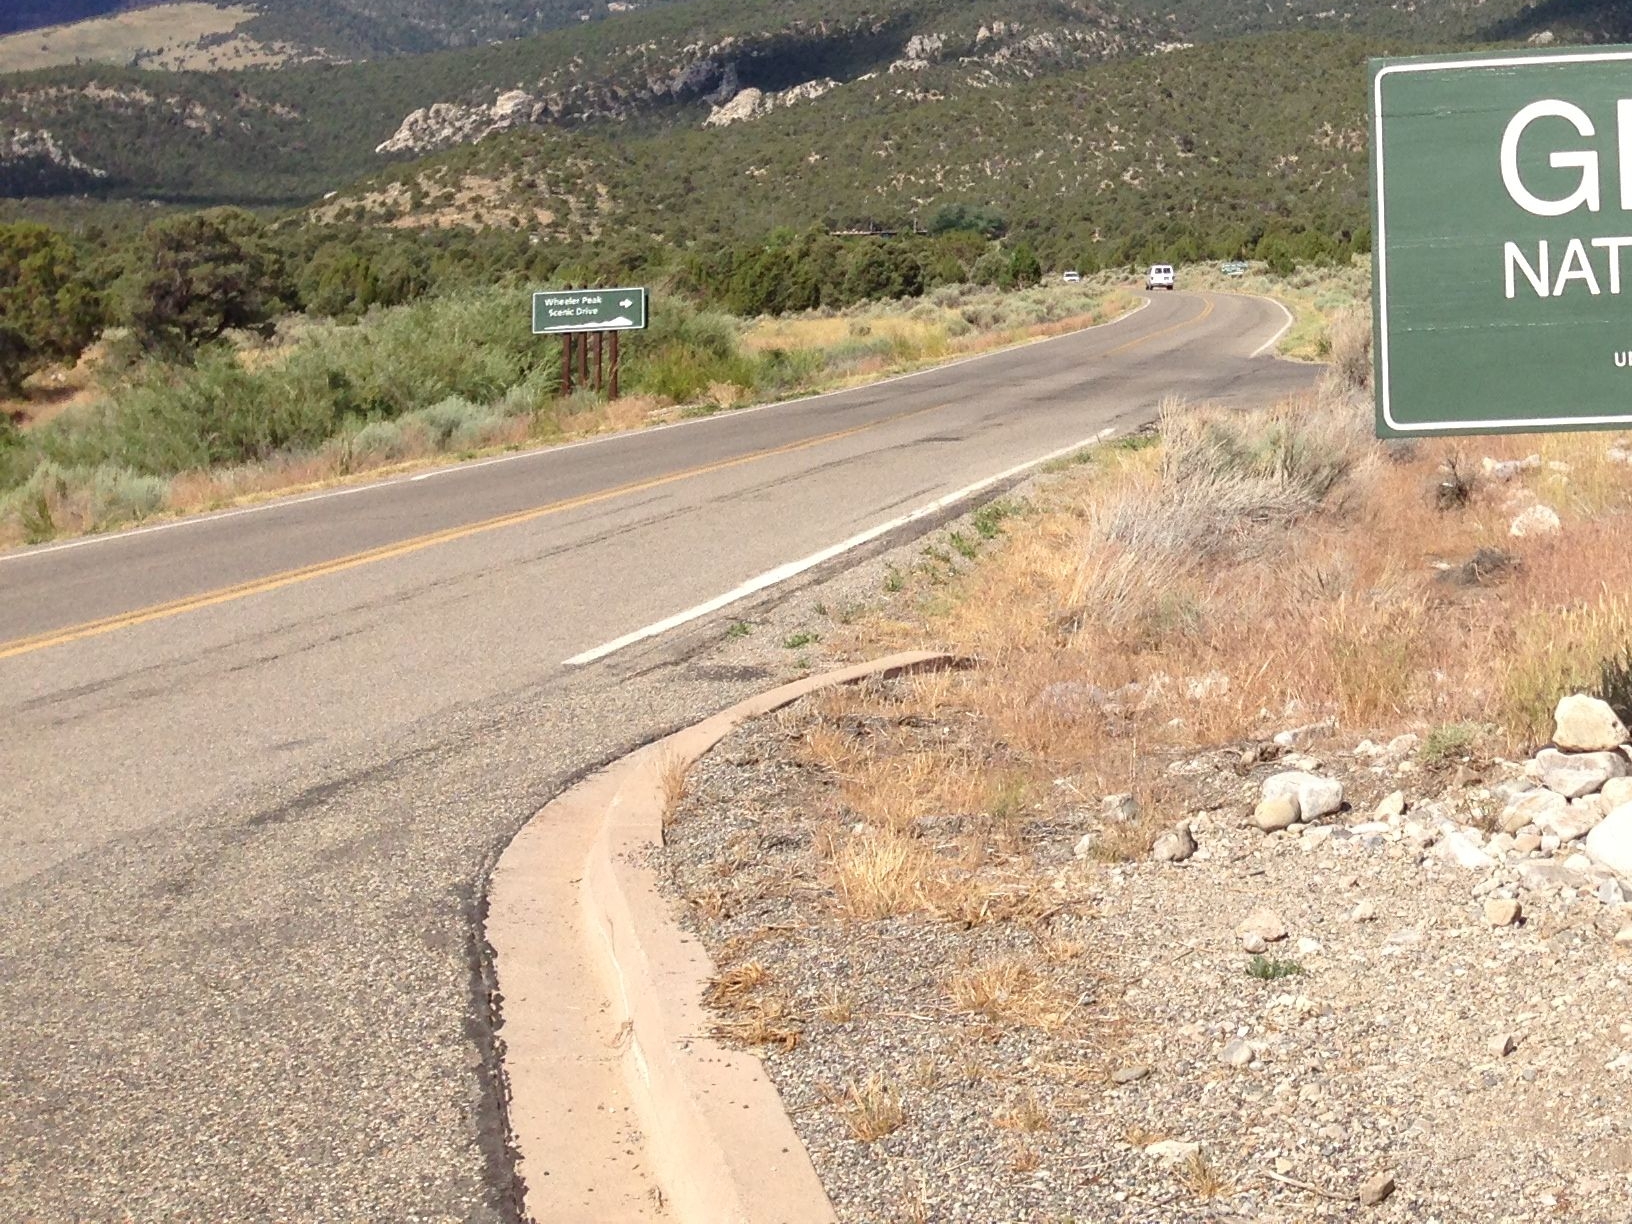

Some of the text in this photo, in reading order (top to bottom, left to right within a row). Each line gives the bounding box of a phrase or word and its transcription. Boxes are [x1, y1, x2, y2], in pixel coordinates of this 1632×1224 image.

[544, 295, 602, 307] Wheeler Peak
[548, 307, 598, 317] Scenic Drive
